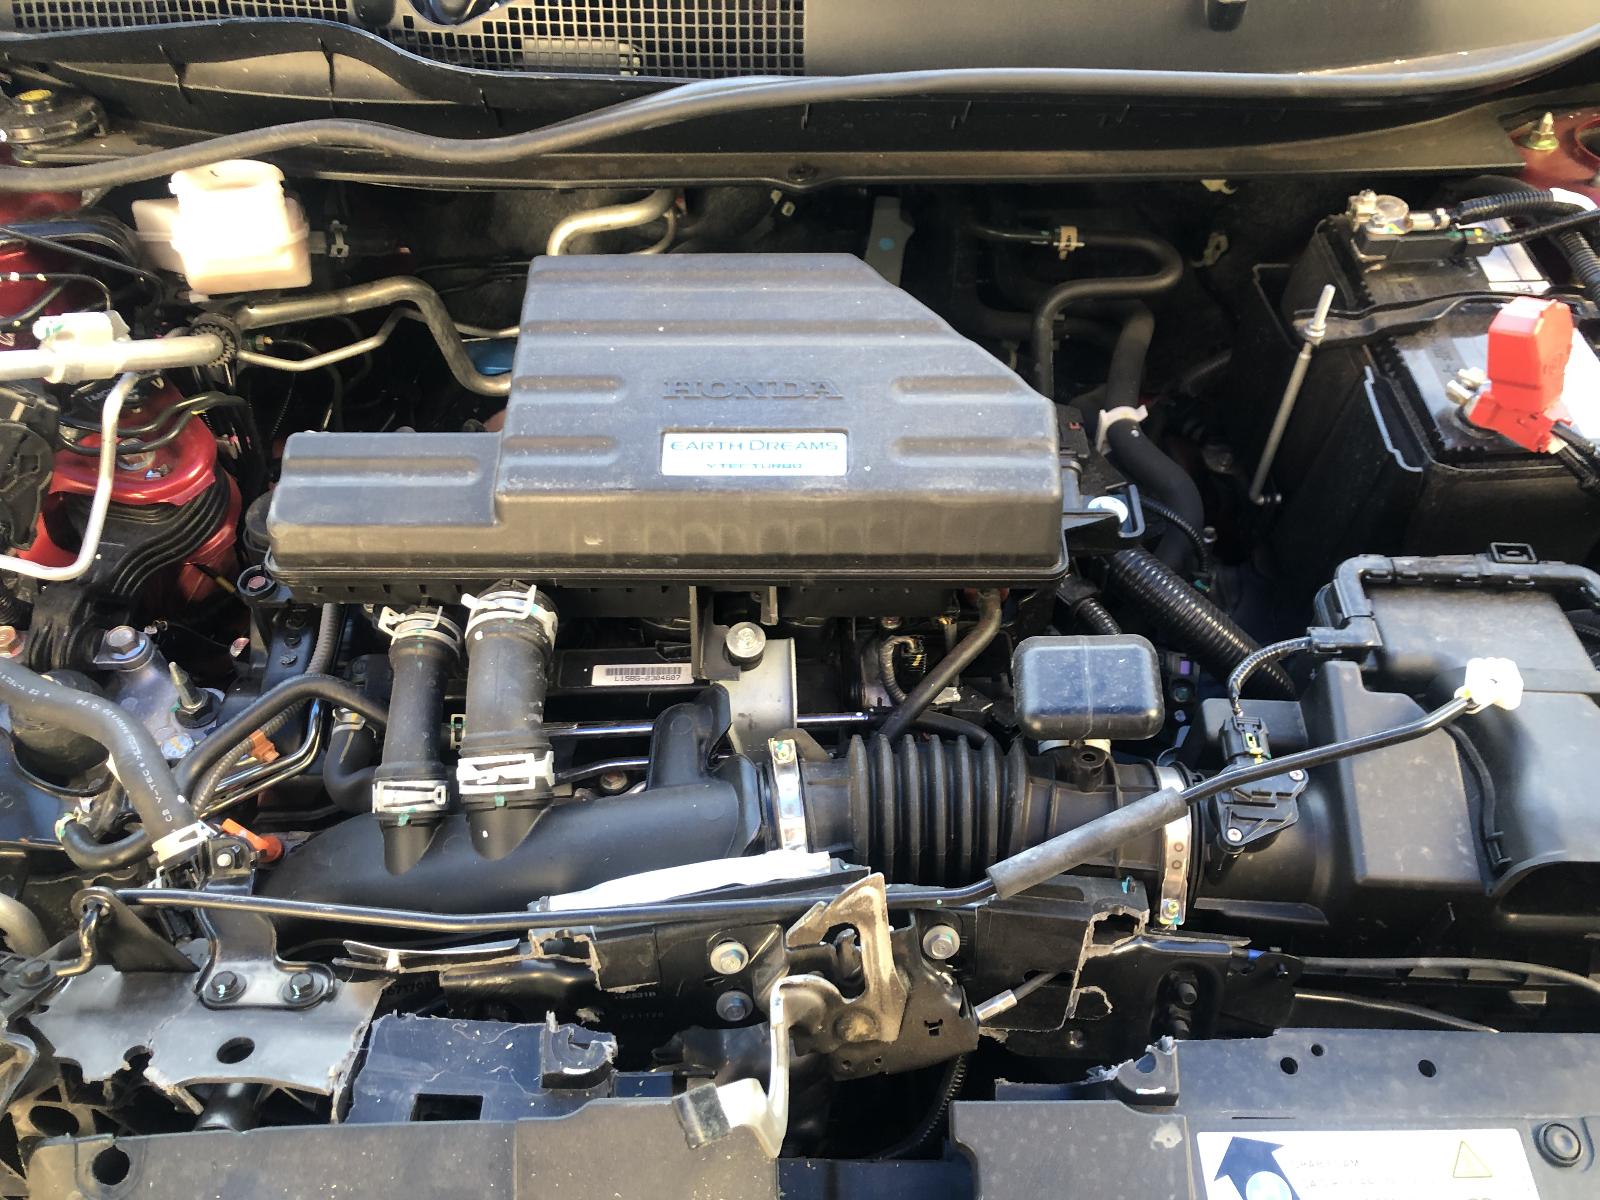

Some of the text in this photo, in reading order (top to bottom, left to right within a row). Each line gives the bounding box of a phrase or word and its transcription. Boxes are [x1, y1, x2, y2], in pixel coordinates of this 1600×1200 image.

[662, 377, 845, 401] HONDA
[671, 439, 839, 452] EARTH DREAMS
